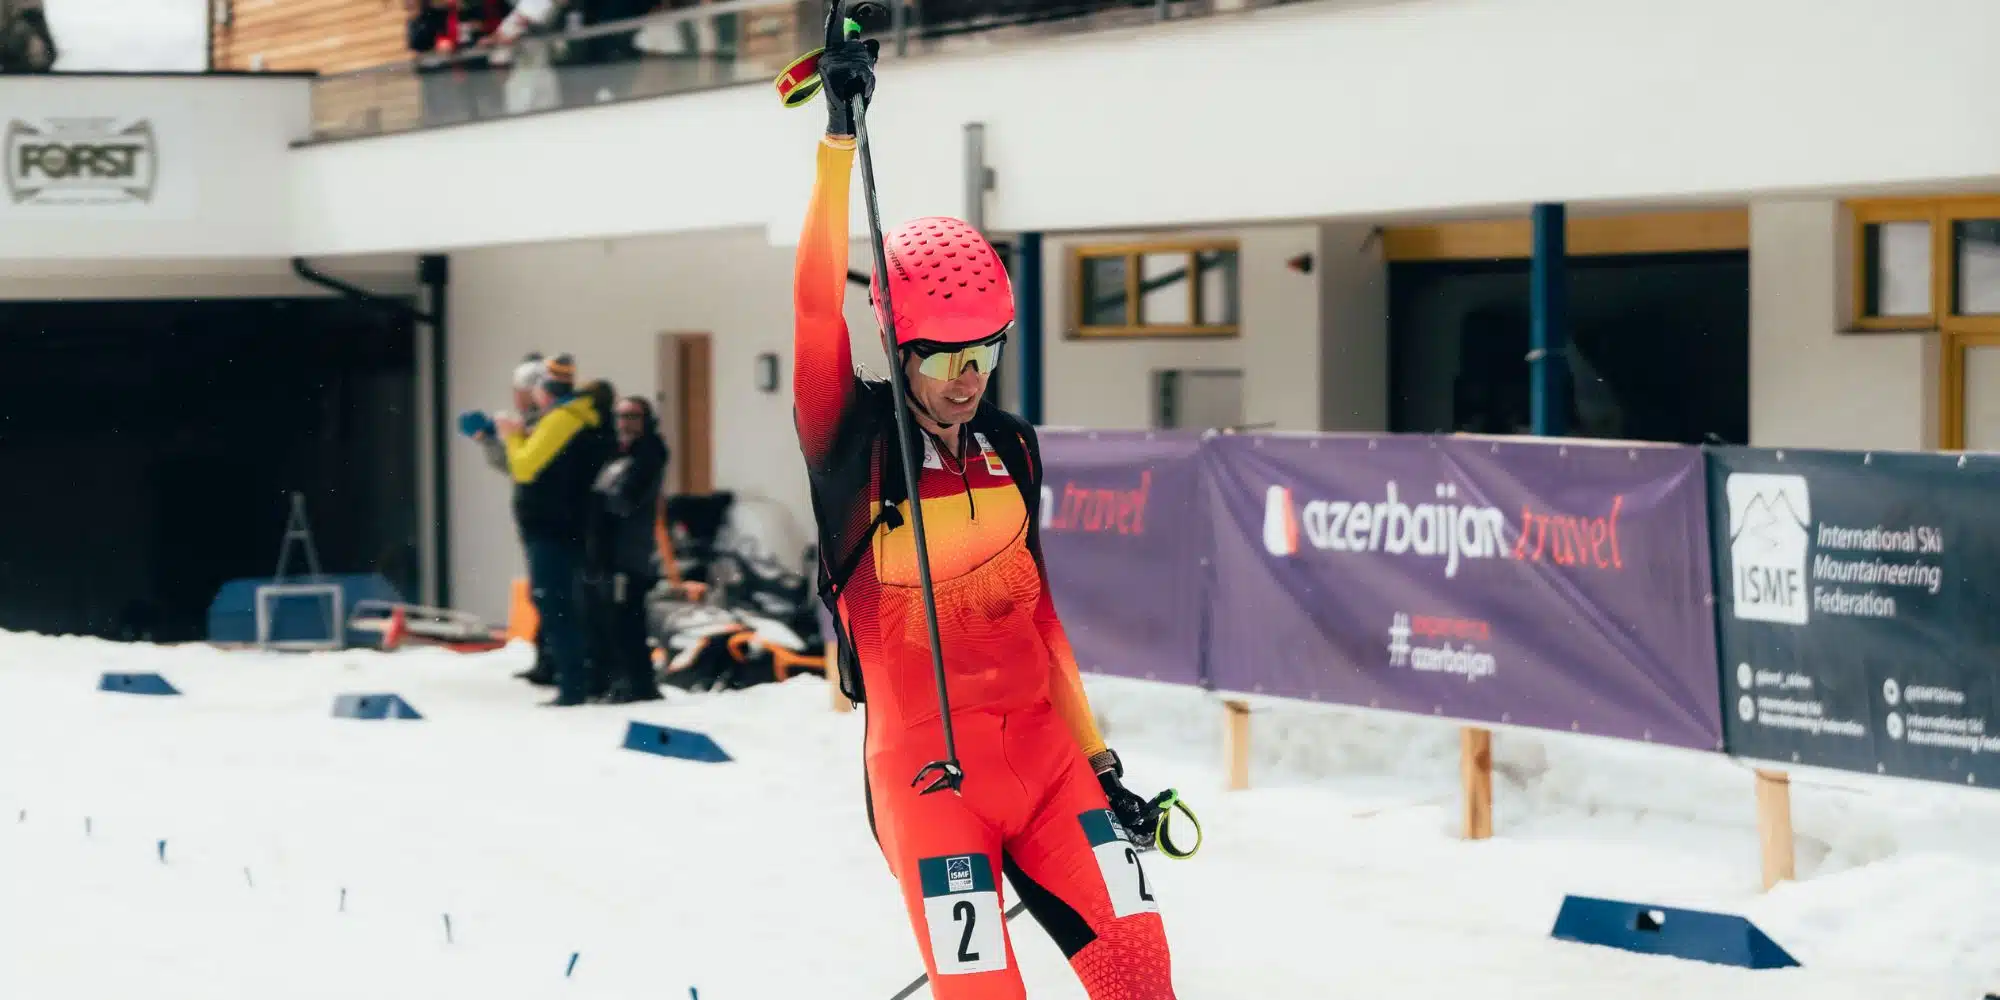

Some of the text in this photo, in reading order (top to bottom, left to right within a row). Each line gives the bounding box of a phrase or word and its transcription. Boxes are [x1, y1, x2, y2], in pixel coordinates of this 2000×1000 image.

[20, 143, 143, 178] FORST
[1817, 521, 1944, 553] International Ski
[1740, 565, 1798, 608] ISMF
[1813, 554, 1943, 593] Mountaineering
[1814, 586, 1896, 617] Federation
[951, 870, 970, 880] ISMF
[1124, 847, 1154, 902] 2
[952, 900, 980, 963] 2
